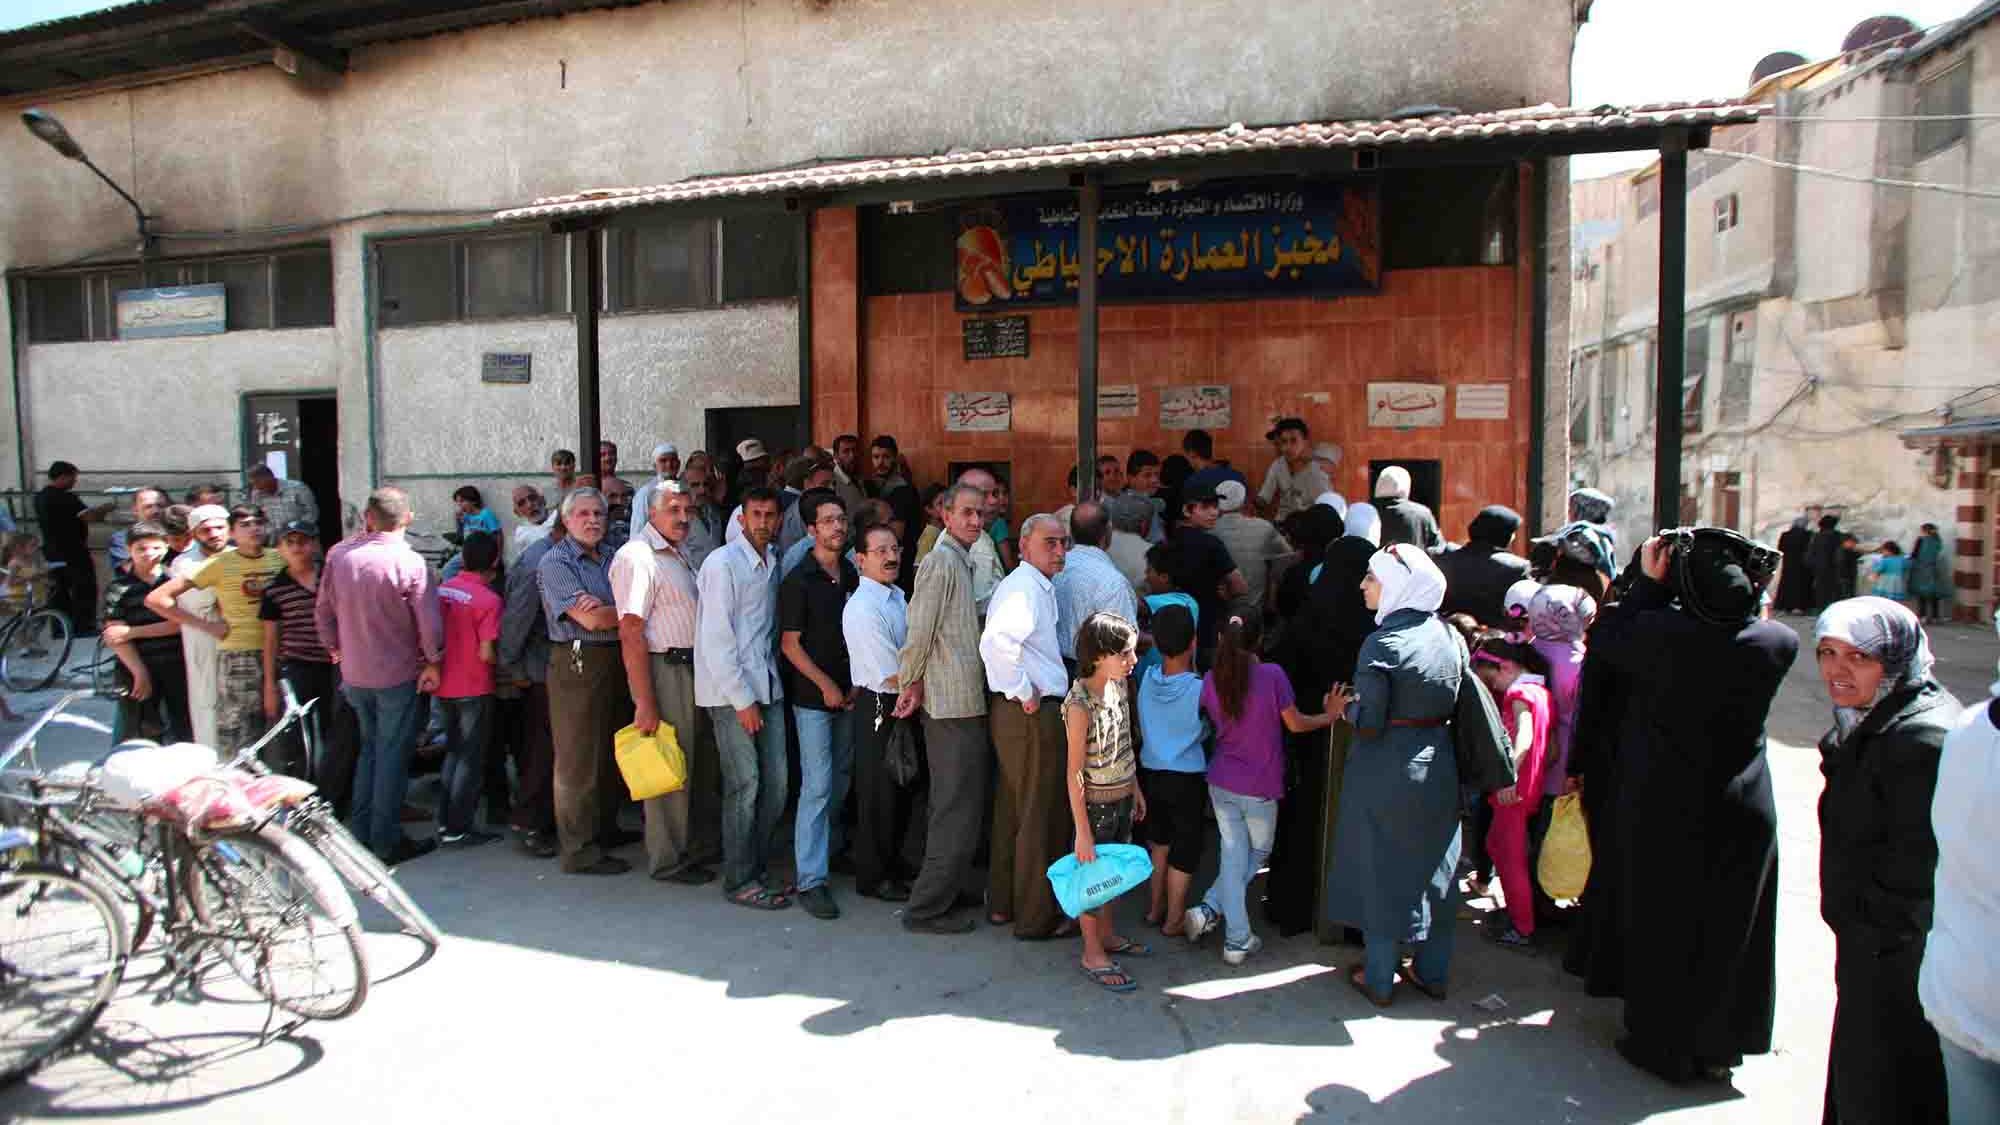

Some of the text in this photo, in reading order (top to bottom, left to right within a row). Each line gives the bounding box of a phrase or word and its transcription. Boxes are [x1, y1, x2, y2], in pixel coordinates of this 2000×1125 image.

[1223, 190, 1272, 213] الاقتصاد
[1273, 191, 1304, 214] وزارة
[1013, 217, 1340, 297] مخبز العمارة الاحياطي
[1371, 391, 1438, 418] نساء
[1086, 883, 1102, 897] BEST
